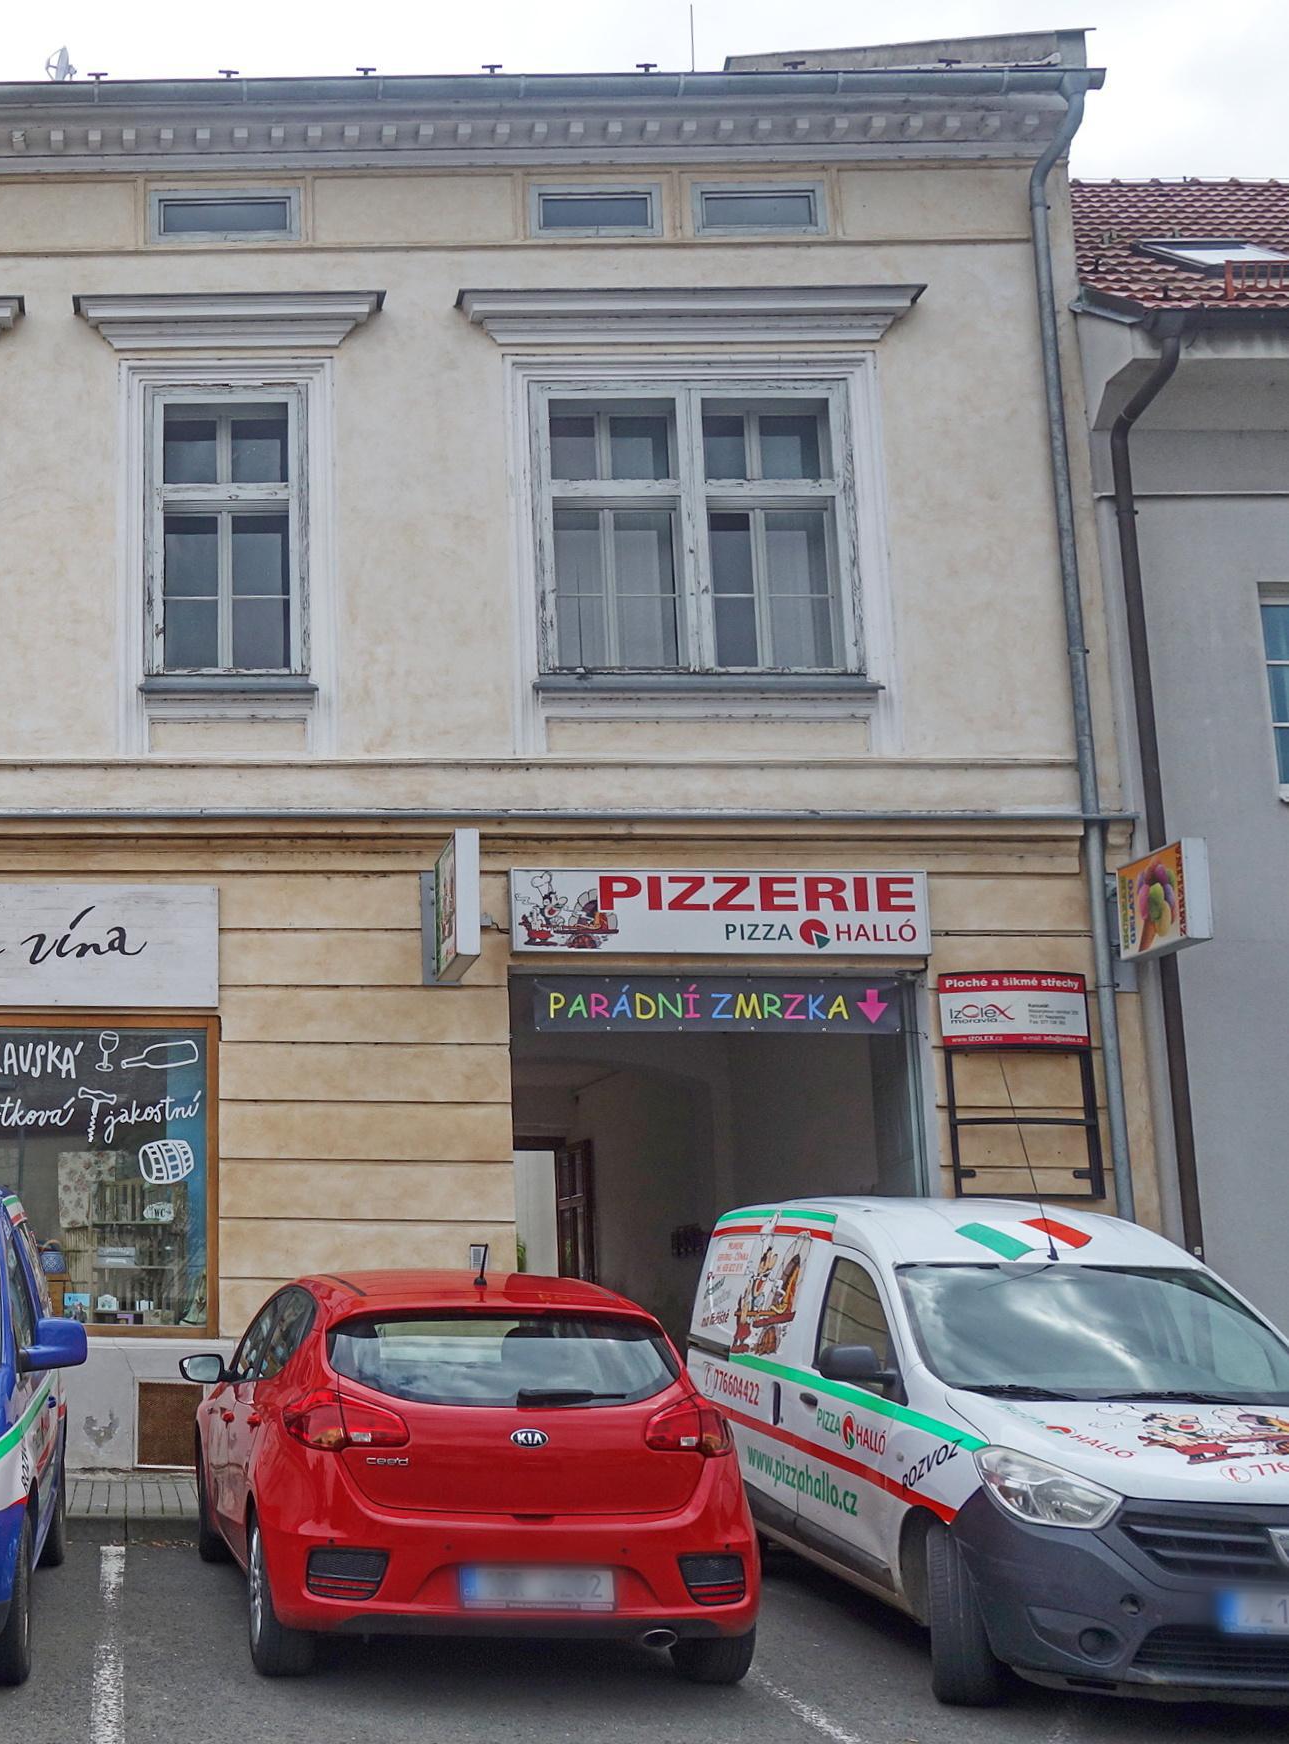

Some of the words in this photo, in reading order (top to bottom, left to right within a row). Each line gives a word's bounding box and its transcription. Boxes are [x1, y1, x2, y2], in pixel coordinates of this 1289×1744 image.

[598, 875, 917, 912] PIZZERIE
[21, 904, 148, 965] vína
[725, 923, 793, 942] PIZZA
[836, 919, 918, 942] HALLÓ
[549, 984, 701, 1020] PARÁDNÍ
[710, 992, 851, 1020] ZMRZKA
[945, 977, 987, 988] Ploché
[1002, 977, 1038, 986] šikmé
[1041, 978, 1079, 990] střechy
[103, 1090, 202, 1143] jakostní
[713, 1368, 760, 1406] 776604422
[517, 1432, 543, 1445] KIA
[817, 1408, 840, 1436] PIZZA
[856, 1429, 886, 1456] HALLÓ
[1070, 1433, 1138, 1459] HALLÓ
[747, 1445, 858, 1516] www.pizzahallo.cz
[901, 1438, 965, 1495] ROZVOZ
